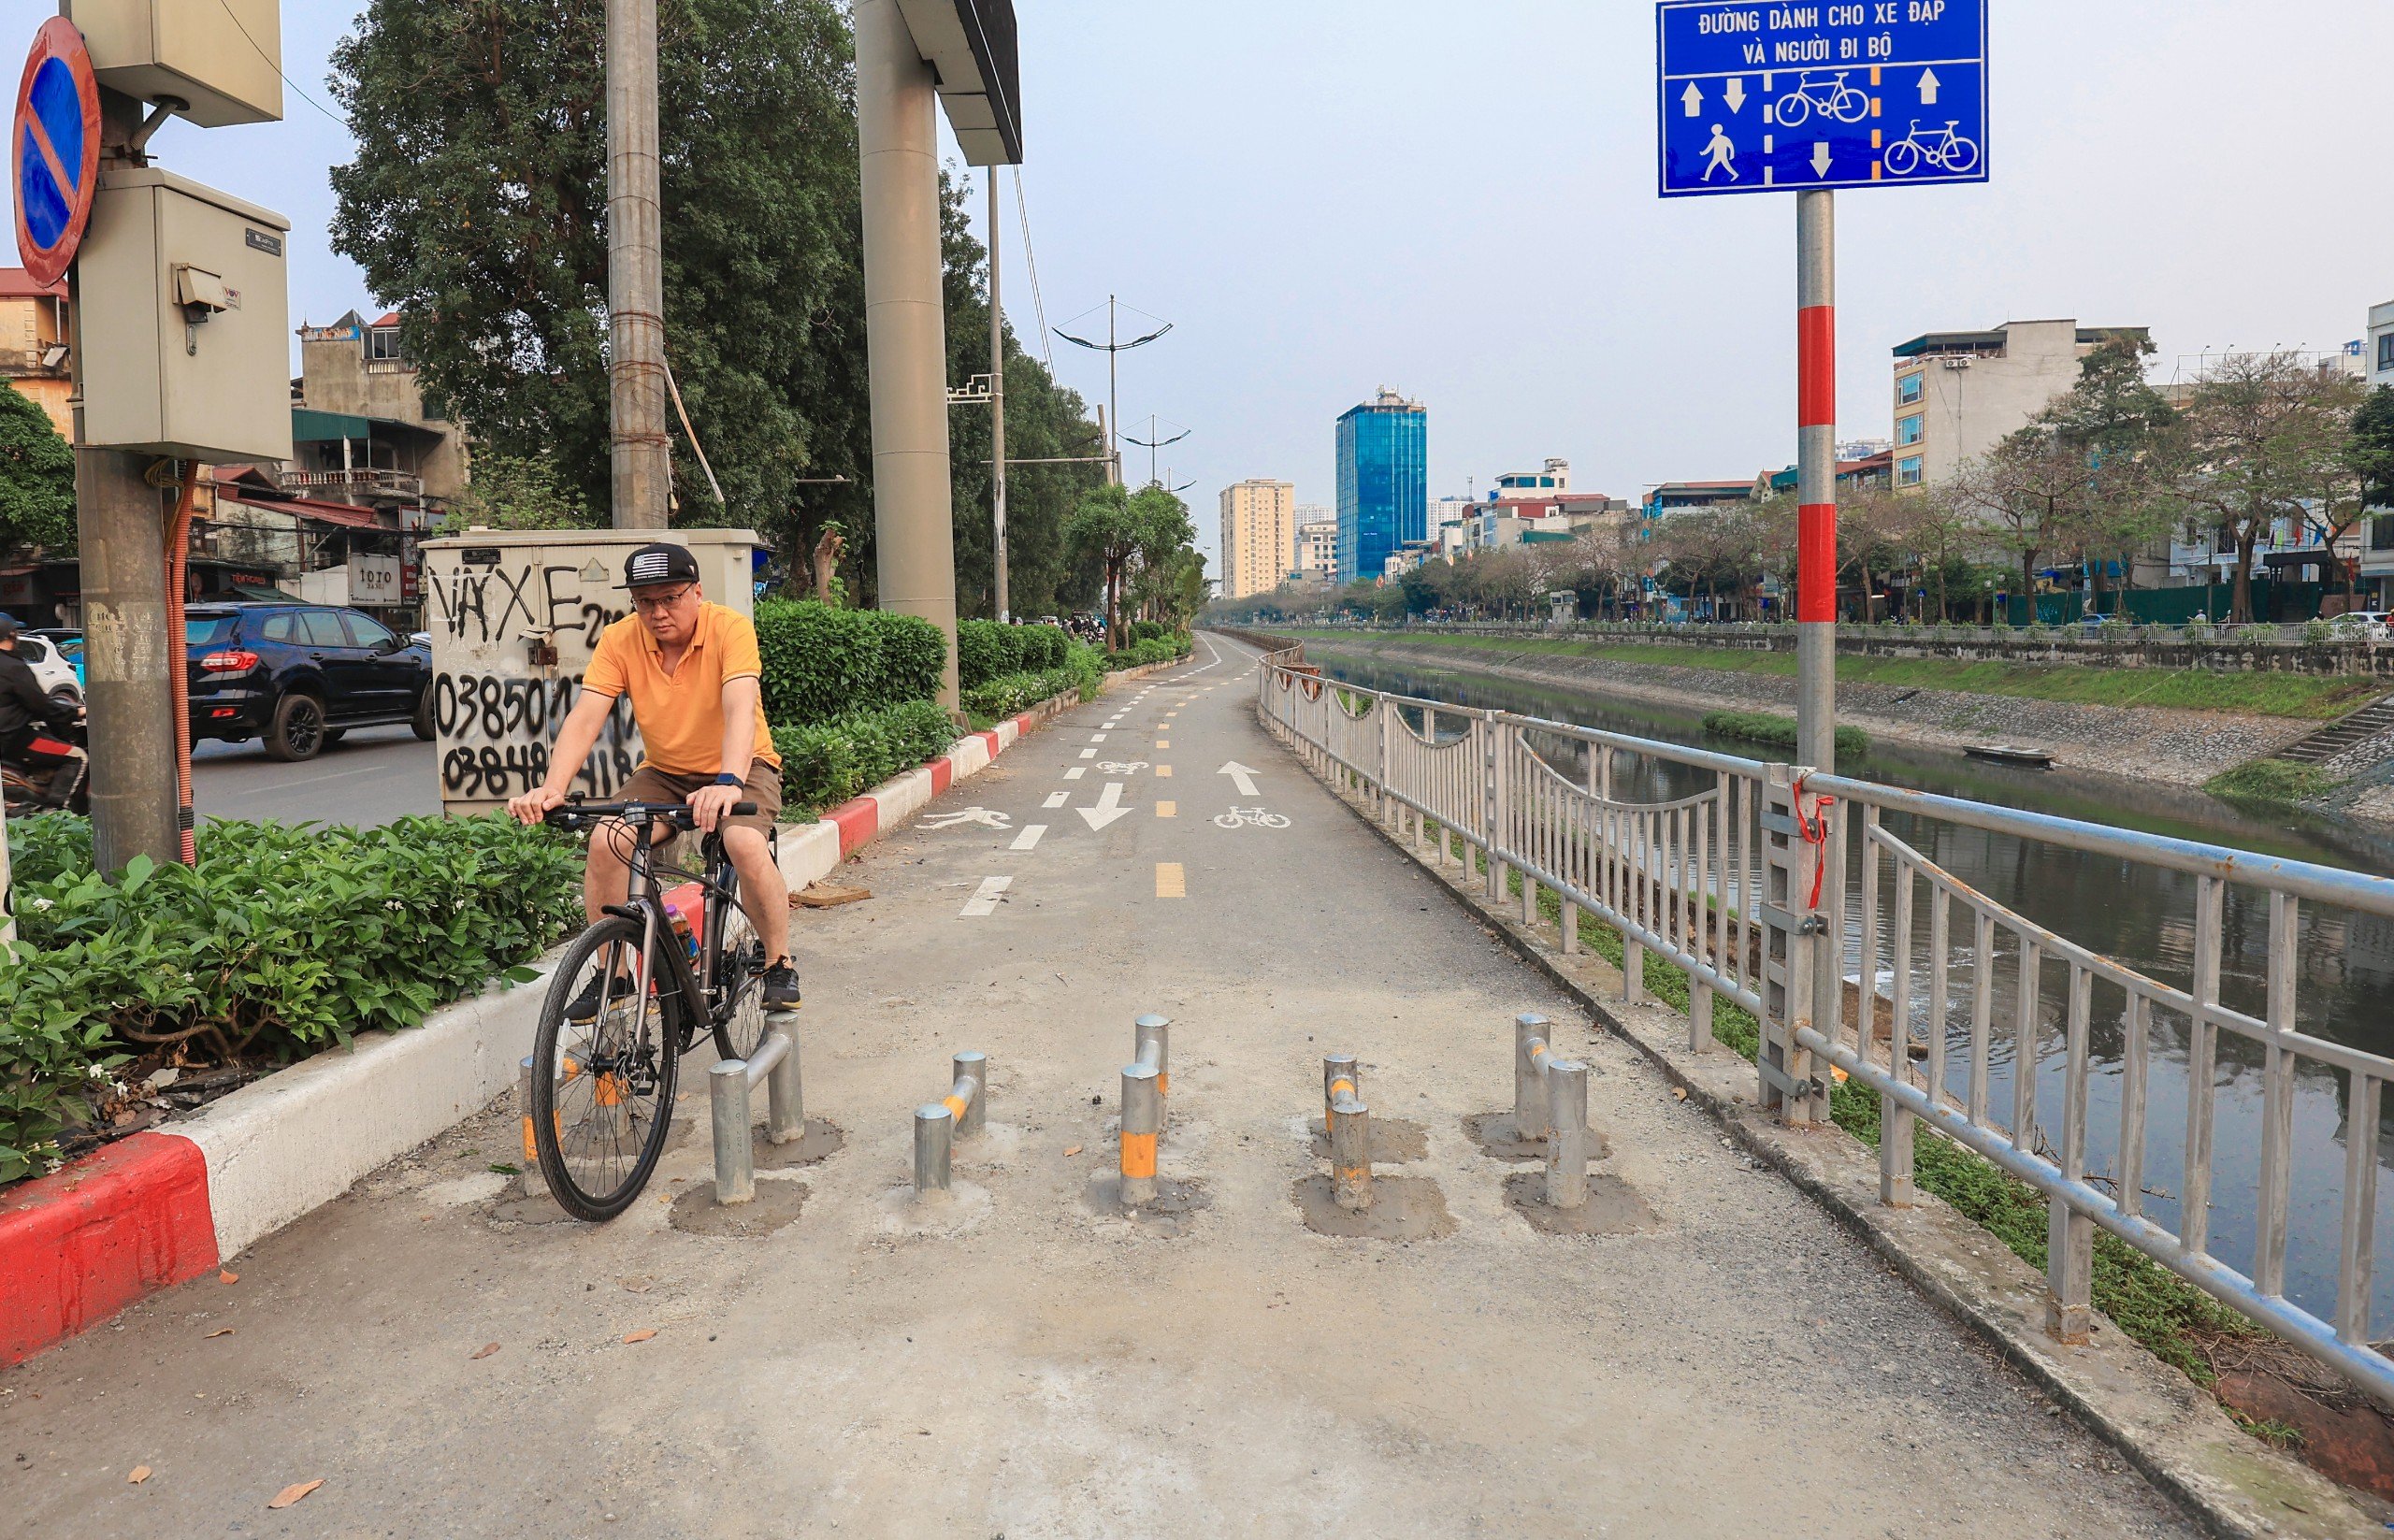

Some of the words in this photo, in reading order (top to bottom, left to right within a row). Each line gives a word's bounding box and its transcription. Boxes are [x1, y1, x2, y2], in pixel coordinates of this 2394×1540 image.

[1698, 7, 1760, 35] ĐƯỜNG
[1769, 3, 1818, 30] DÀNH
[1828, 5, 1864, 26] CHO
[1874, 3, 1897, 23] XE
[1908, 0, 1945, 25] ĐẠP
[1742, 37, 1766, 64] VÀ
[1775, 34, 1830, 62] NGƯỜI
[1839, 37, 1857, 58] ĐI
[1868, 31, 1892, 61] BỘ
